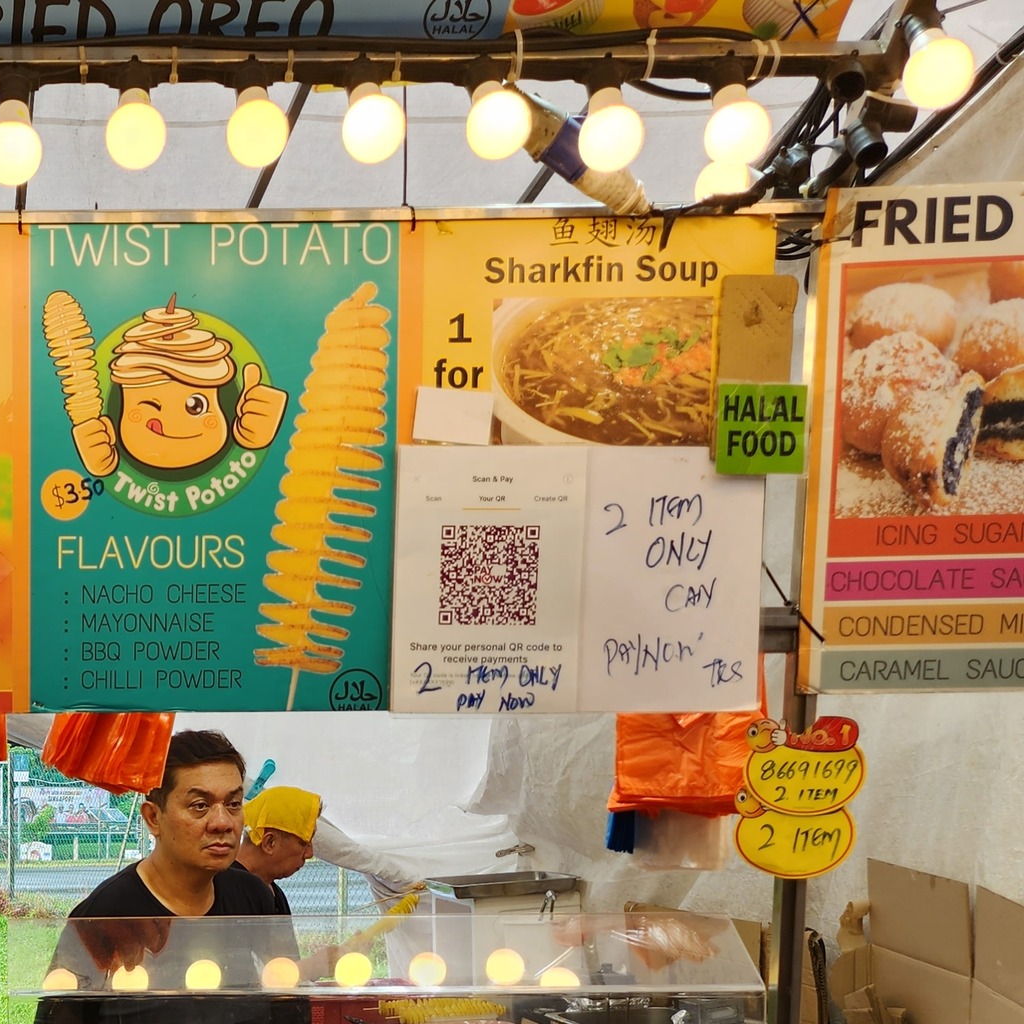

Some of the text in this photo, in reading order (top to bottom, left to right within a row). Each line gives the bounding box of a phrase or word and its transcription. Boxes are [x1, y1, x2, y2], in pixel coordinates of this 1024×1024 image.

[432, 24, 476, 35] HALAL
[851, 195, 1013, 247] FRIED
[38, 224, 391, 266] TWIST POTATO
[484, 255, 718, 288] Sharkfin Soup
[448, 313, 472, 343] 1
[434, 358, 484, 389] for
[723, 395, 804, 422] HALAL
[727, 431, 796, 457] FOOD
[604, 494, 703, 535] 2 ITEM
[876, 524, 937, 545] ICING
[58, 535, 245, 569] FLAVOURS
[646, 530, 712, 570] ONLY
[831, 569, 975, 592] CHOCOLATE
[82, 584, 246, 604] NACHO CHEESE
[82, 613, 215, 633] MAYONNAISE
[839, 614, 984, 637] CONDENSED
[82, 641, 220, 662] BBQ POWDER
[410, 642, 549, 654] Share your personal QR code
[443, 655, 528, 666] receive payments
[840, 659, 949, 681] CARAMEL
[81, 669, 242, 689] CHILLI POWDER
[761, 759, 858, 784] 86691699
[775, 786, 838, 802] 2 ITEM
[758, 824, 841, 861] 2 ITEM
